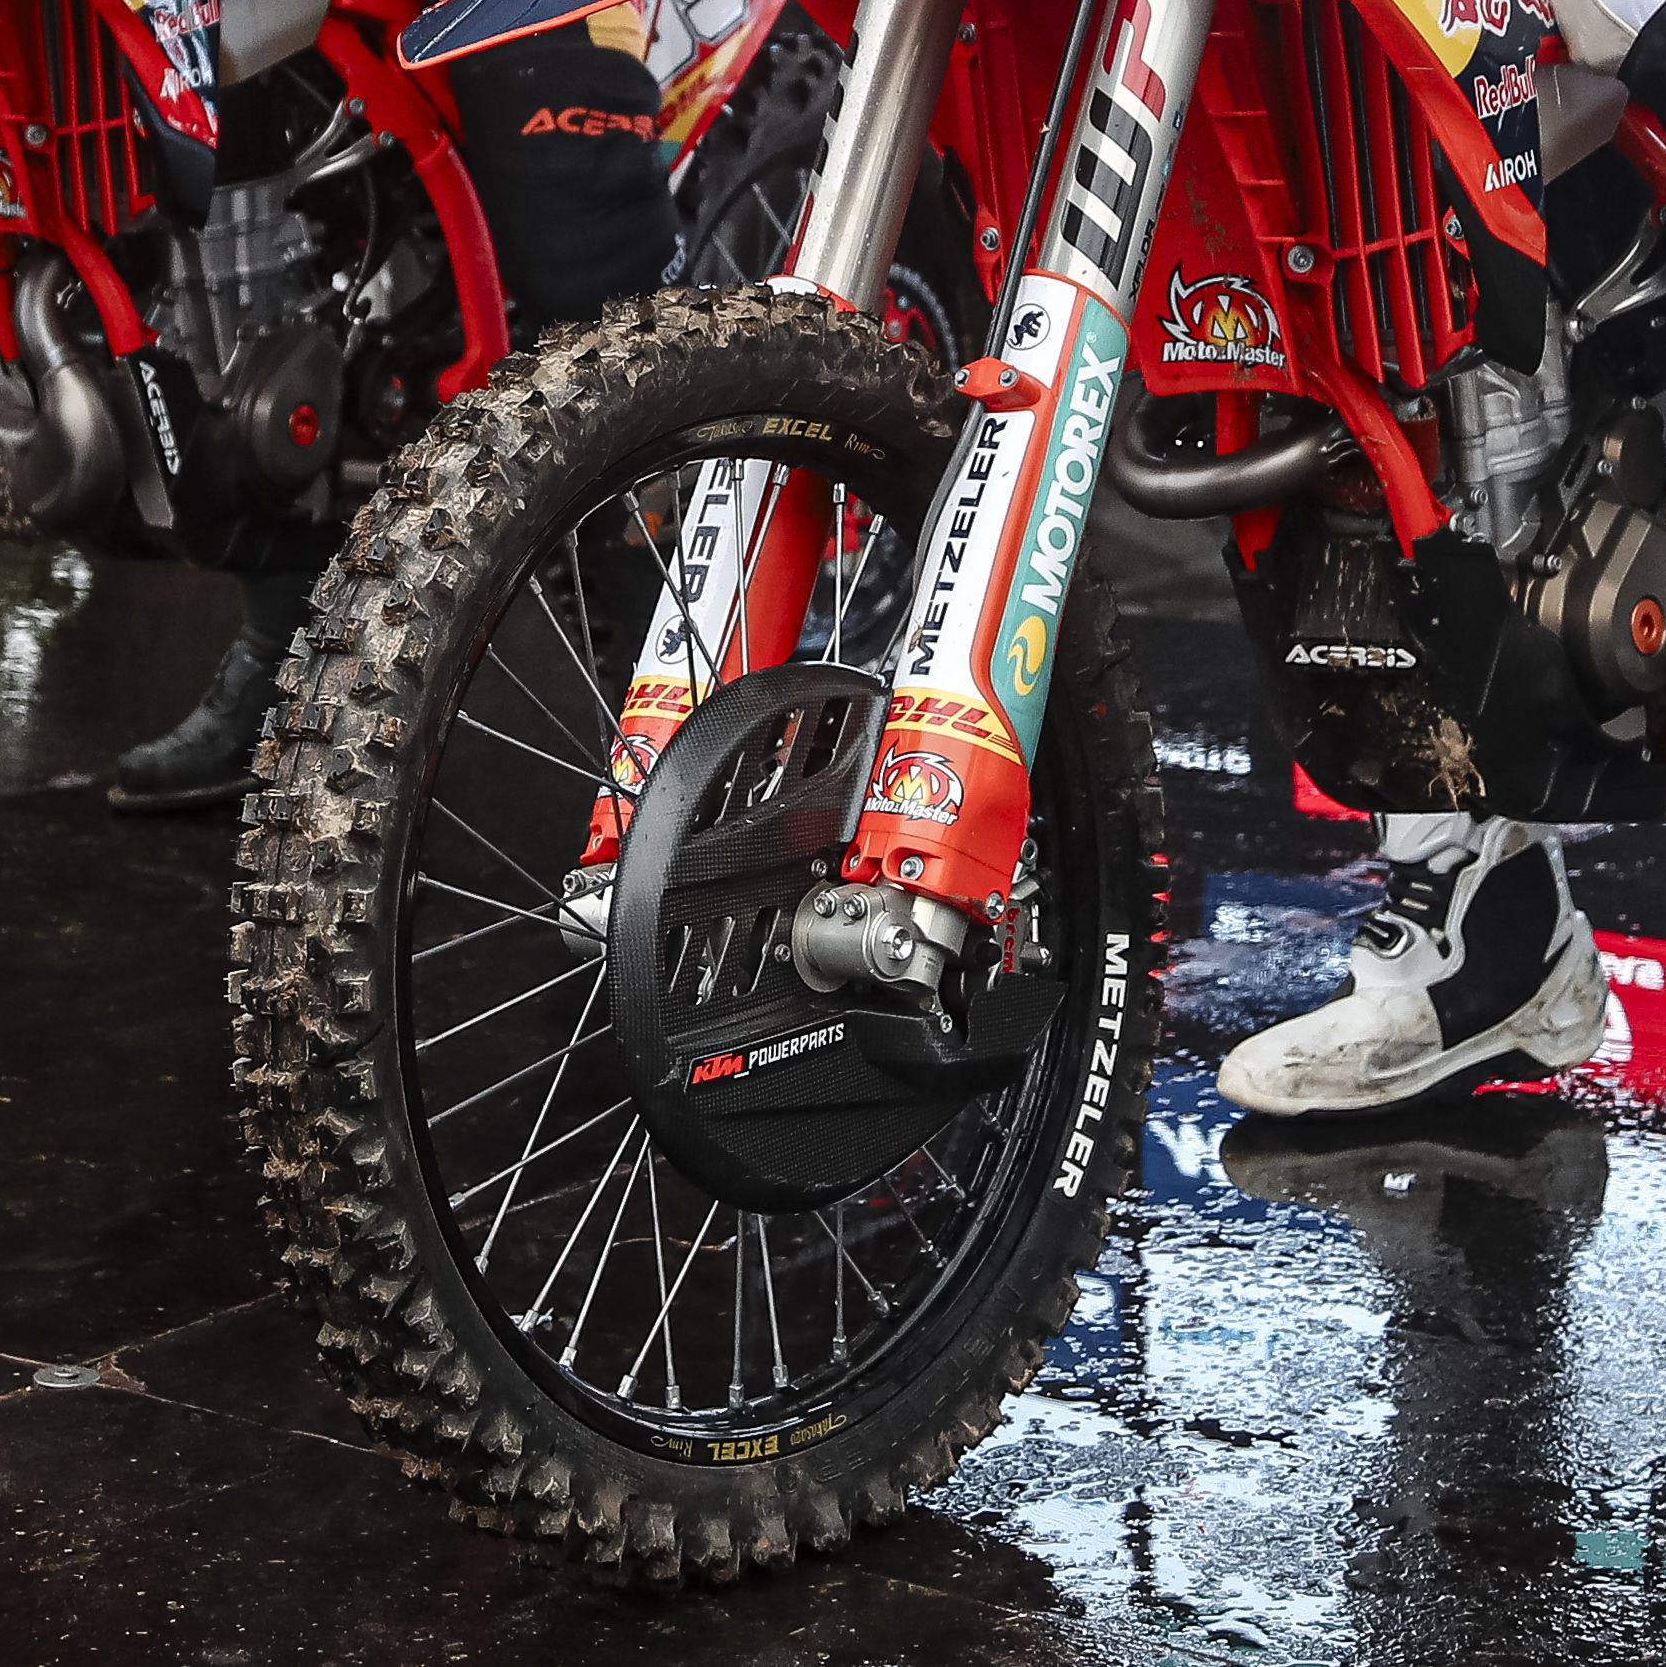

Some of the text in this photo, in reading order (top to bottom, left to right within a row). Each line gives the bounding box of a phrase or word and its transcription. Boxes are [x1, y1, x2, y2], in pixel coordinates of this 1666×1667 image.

[1476, 75, 1509, 119] Red
[1484, 149, 1536, 193] AIROH
[138, 358, 183, 476] ACERBIS
[762, 417, 833, 442] EXCEL
[1040, 348, 1123, 618] MOTOREX
[909, 419, 1008, 677] METZELER
[1285, 642, 1417, 671] ACERBIS
[886, 695, 994, 740] DHL
[692, 1051, 744, 1087] KTM
[1050, 931, 1132, 1200] METZELER
[707, 1435, 779, 1462] EXCEL
